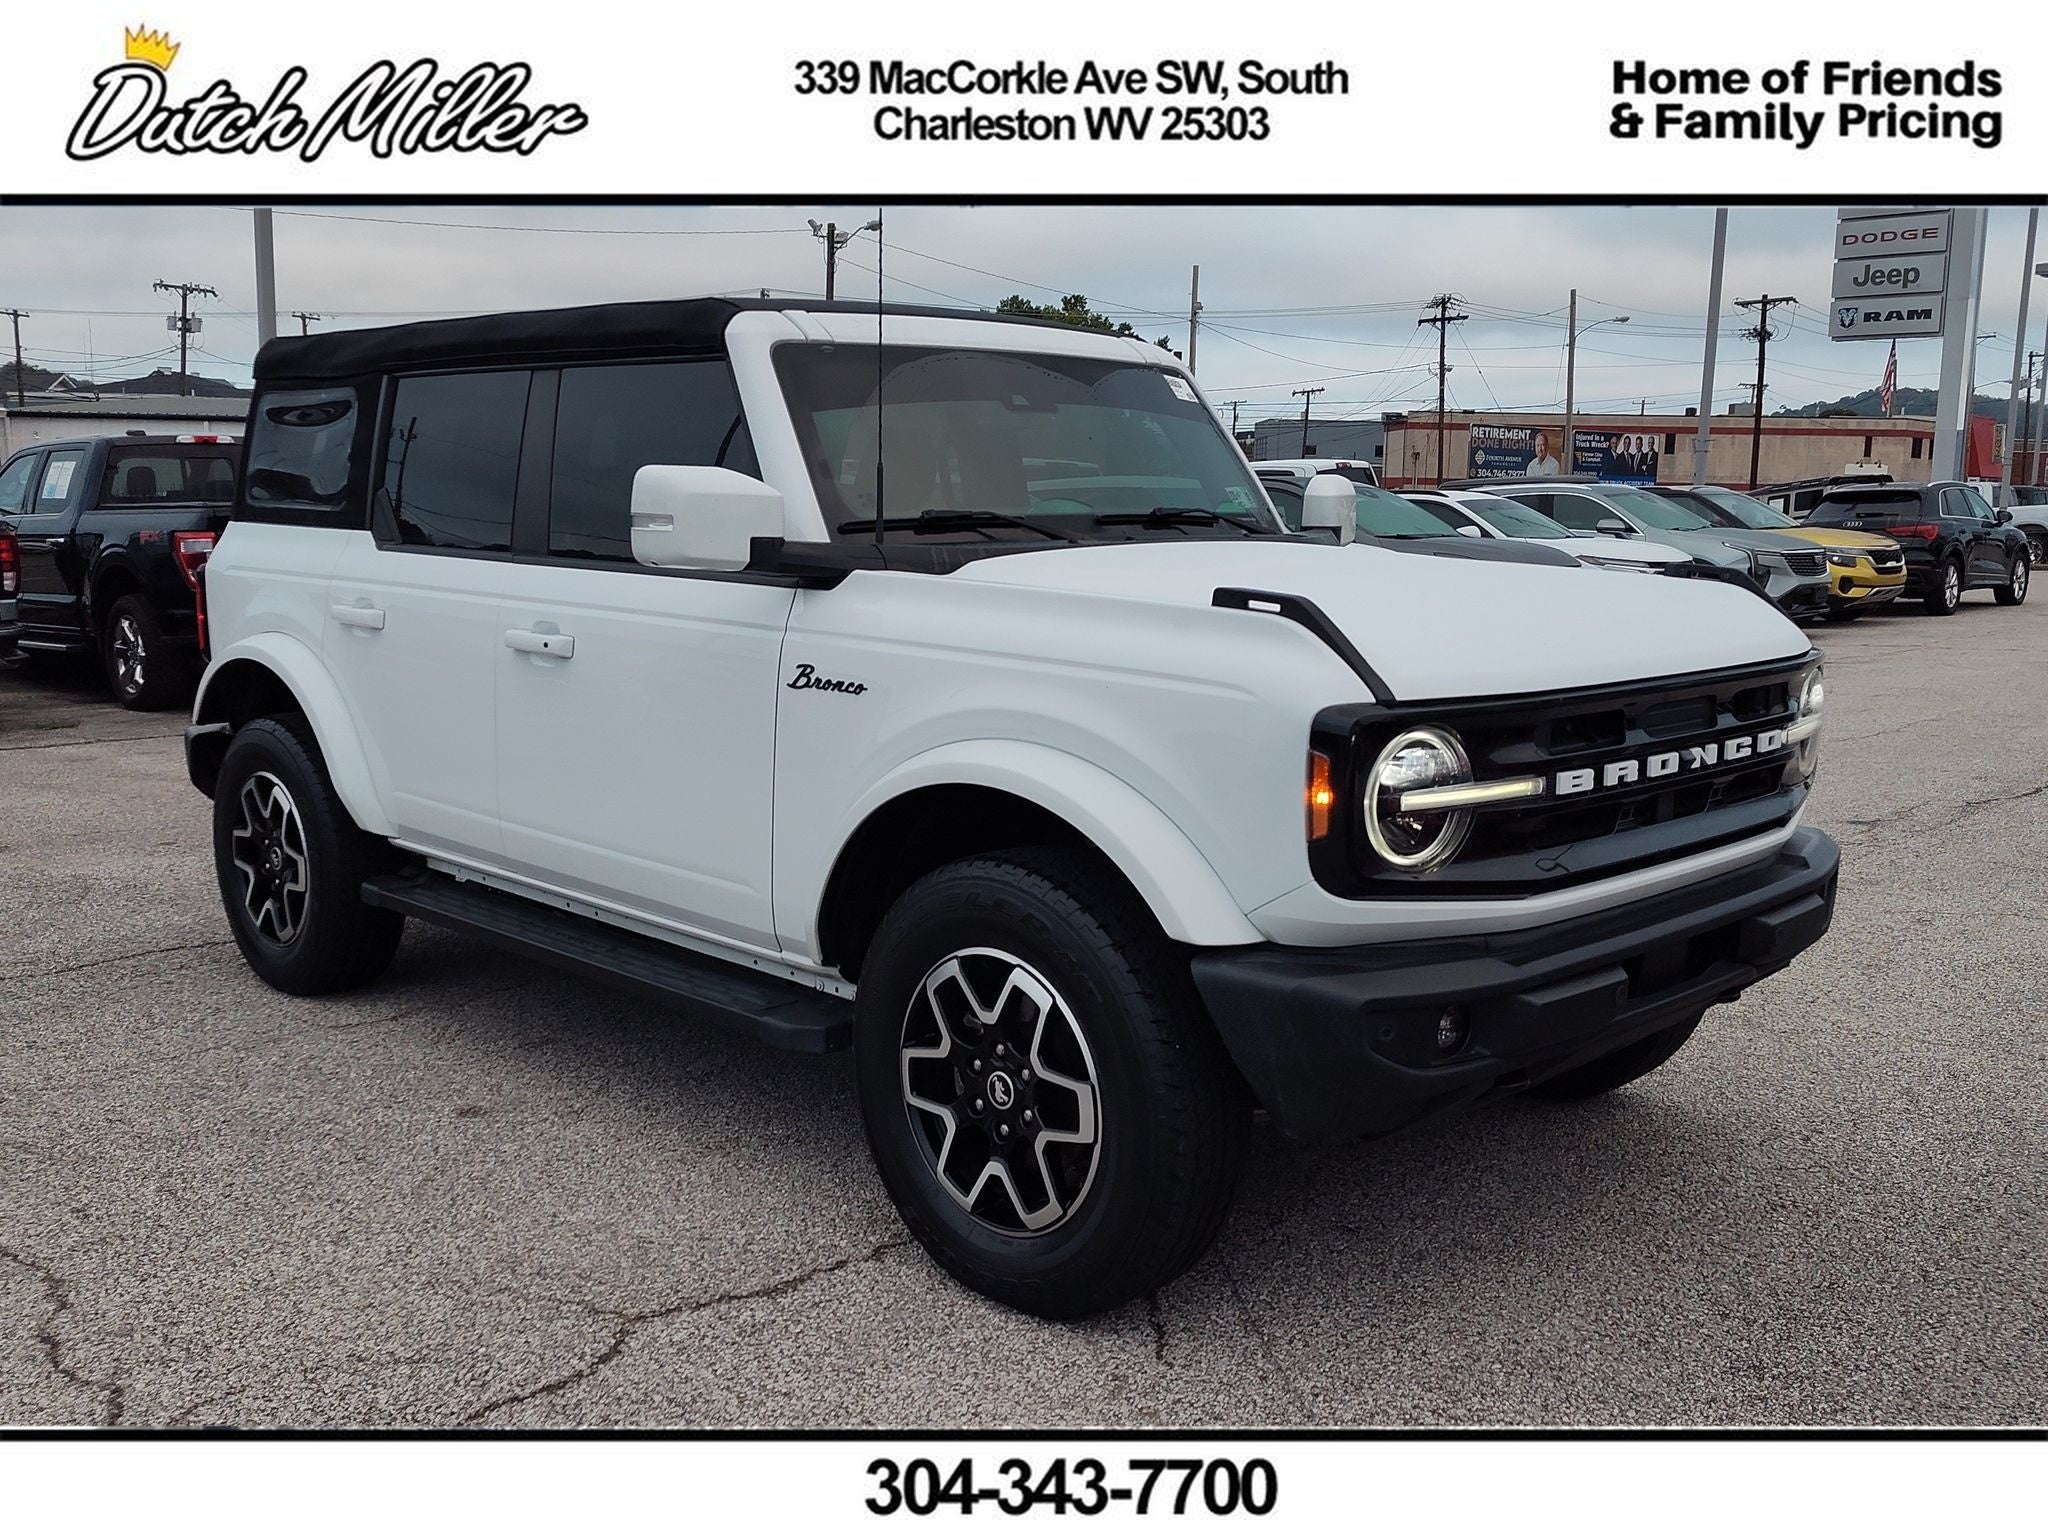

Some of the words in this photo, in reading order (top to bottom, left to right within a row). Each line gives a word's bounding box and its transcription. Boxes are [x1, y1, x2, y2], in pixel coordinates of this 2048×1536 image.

[1842, 227, 1939, 245] DODGE
[1853, 264, 1920, 288] Jeep
[1863, 308, 1932, 322] RAM
[1472, 427, 1531, 440] RETIREMENT
[1472, 437, 1499, 449] DONE
[1502, 439, 1534, 450] RIGHT!
[1591, 441, 1610, 449] Wreck?
[786, 663, 868, 695] Bronco
[1555, 729, 1783, 795] BRONCO
